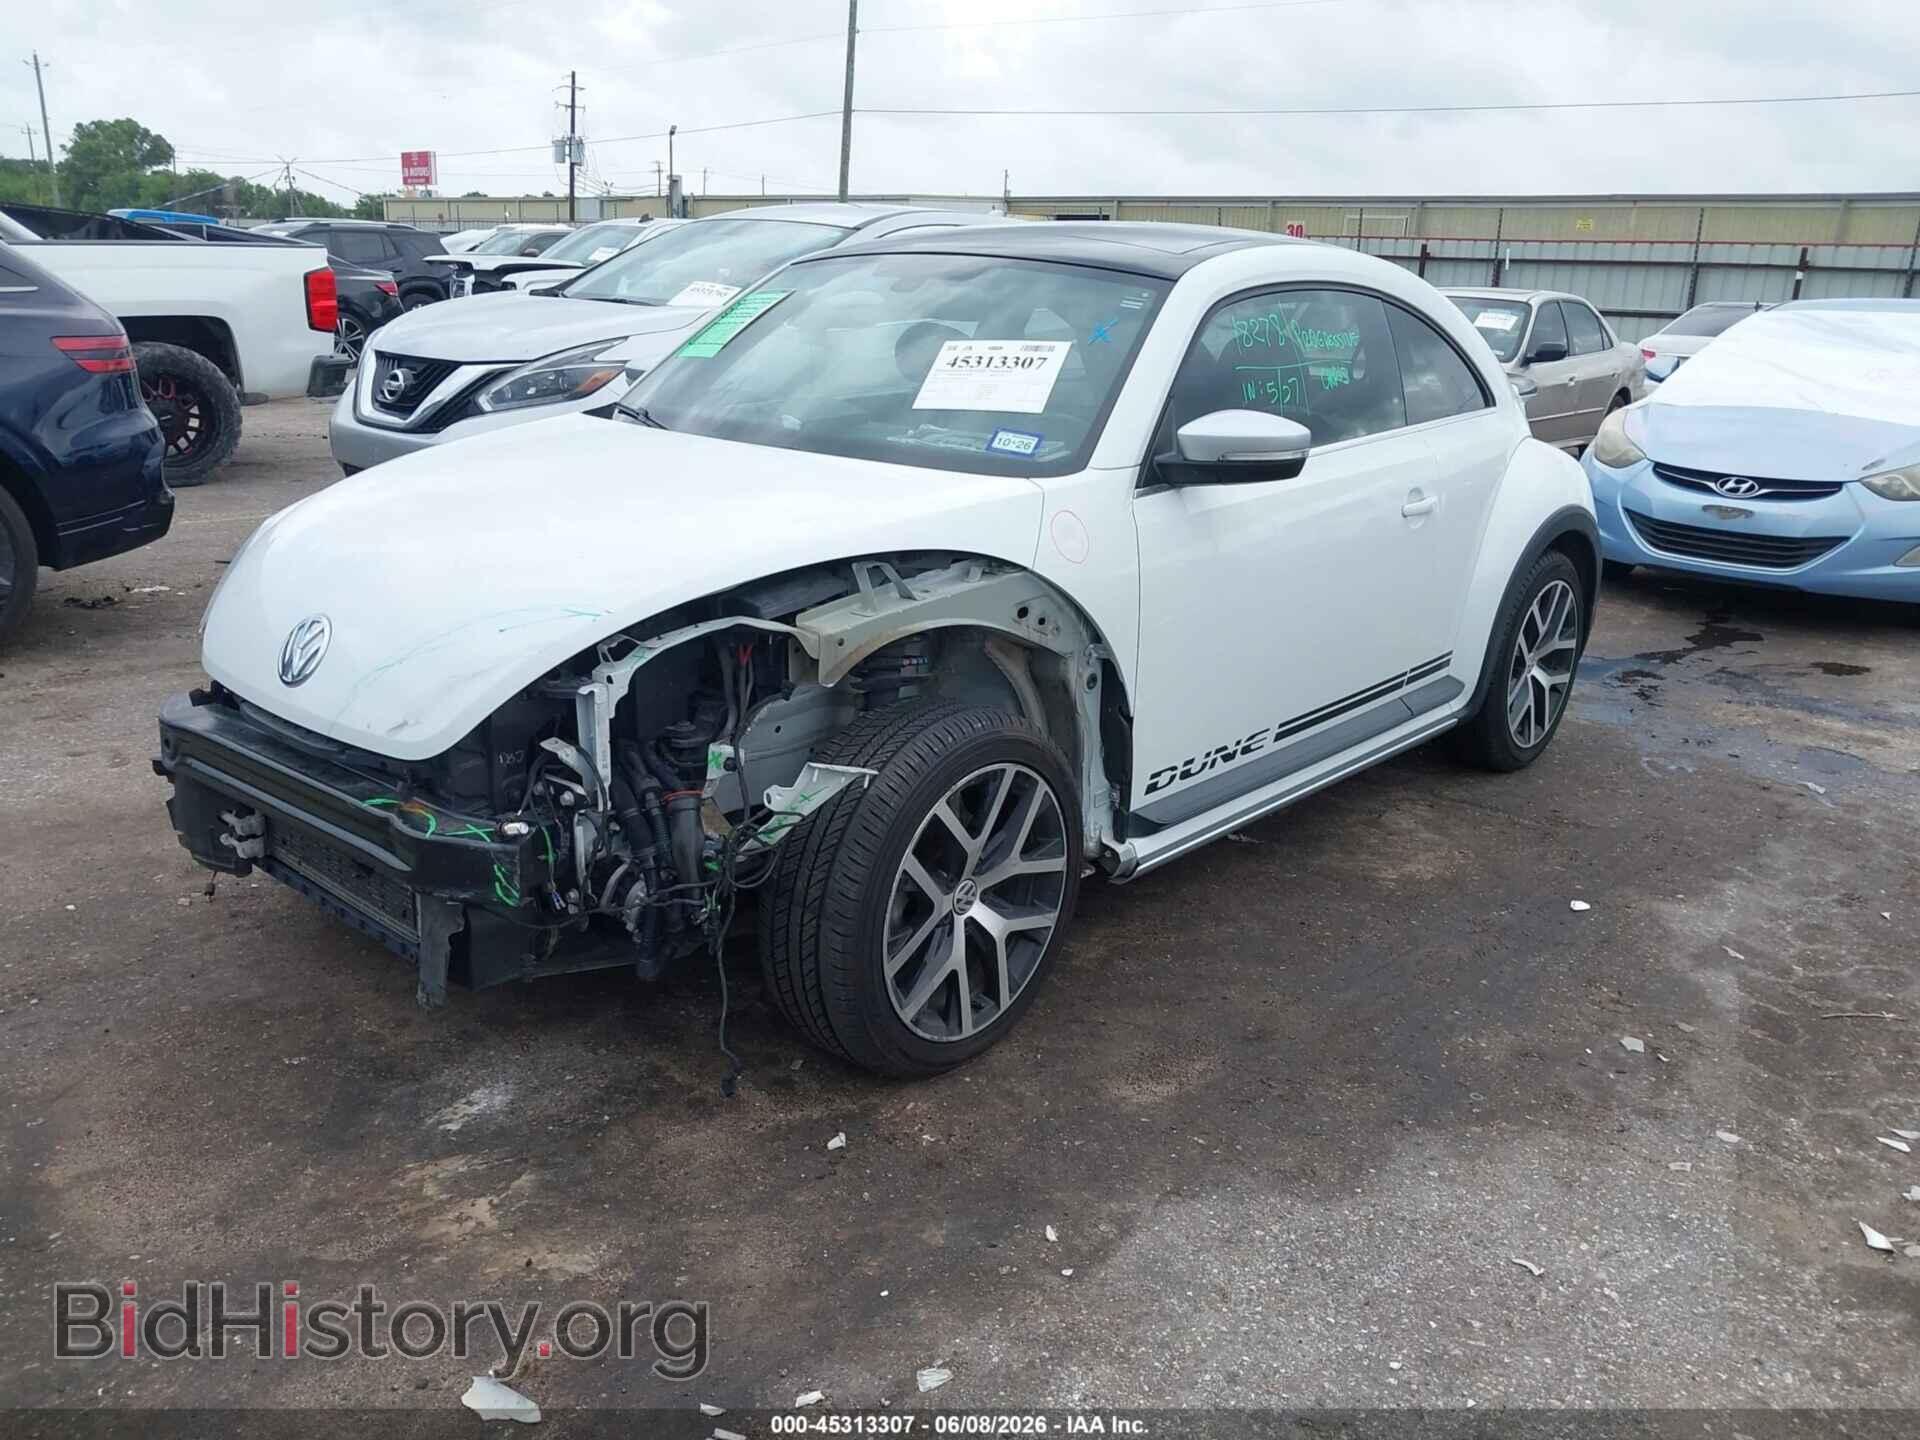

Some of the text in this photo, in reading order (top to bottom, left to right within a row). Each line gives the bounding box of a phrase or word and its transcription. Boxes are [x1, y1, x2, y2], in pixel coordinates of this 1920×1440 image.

[1287, 224, 1303, 237] 30
[945, 355, 1048, 370] 45313307
[1144, 728, 1271, 796] DUNE
